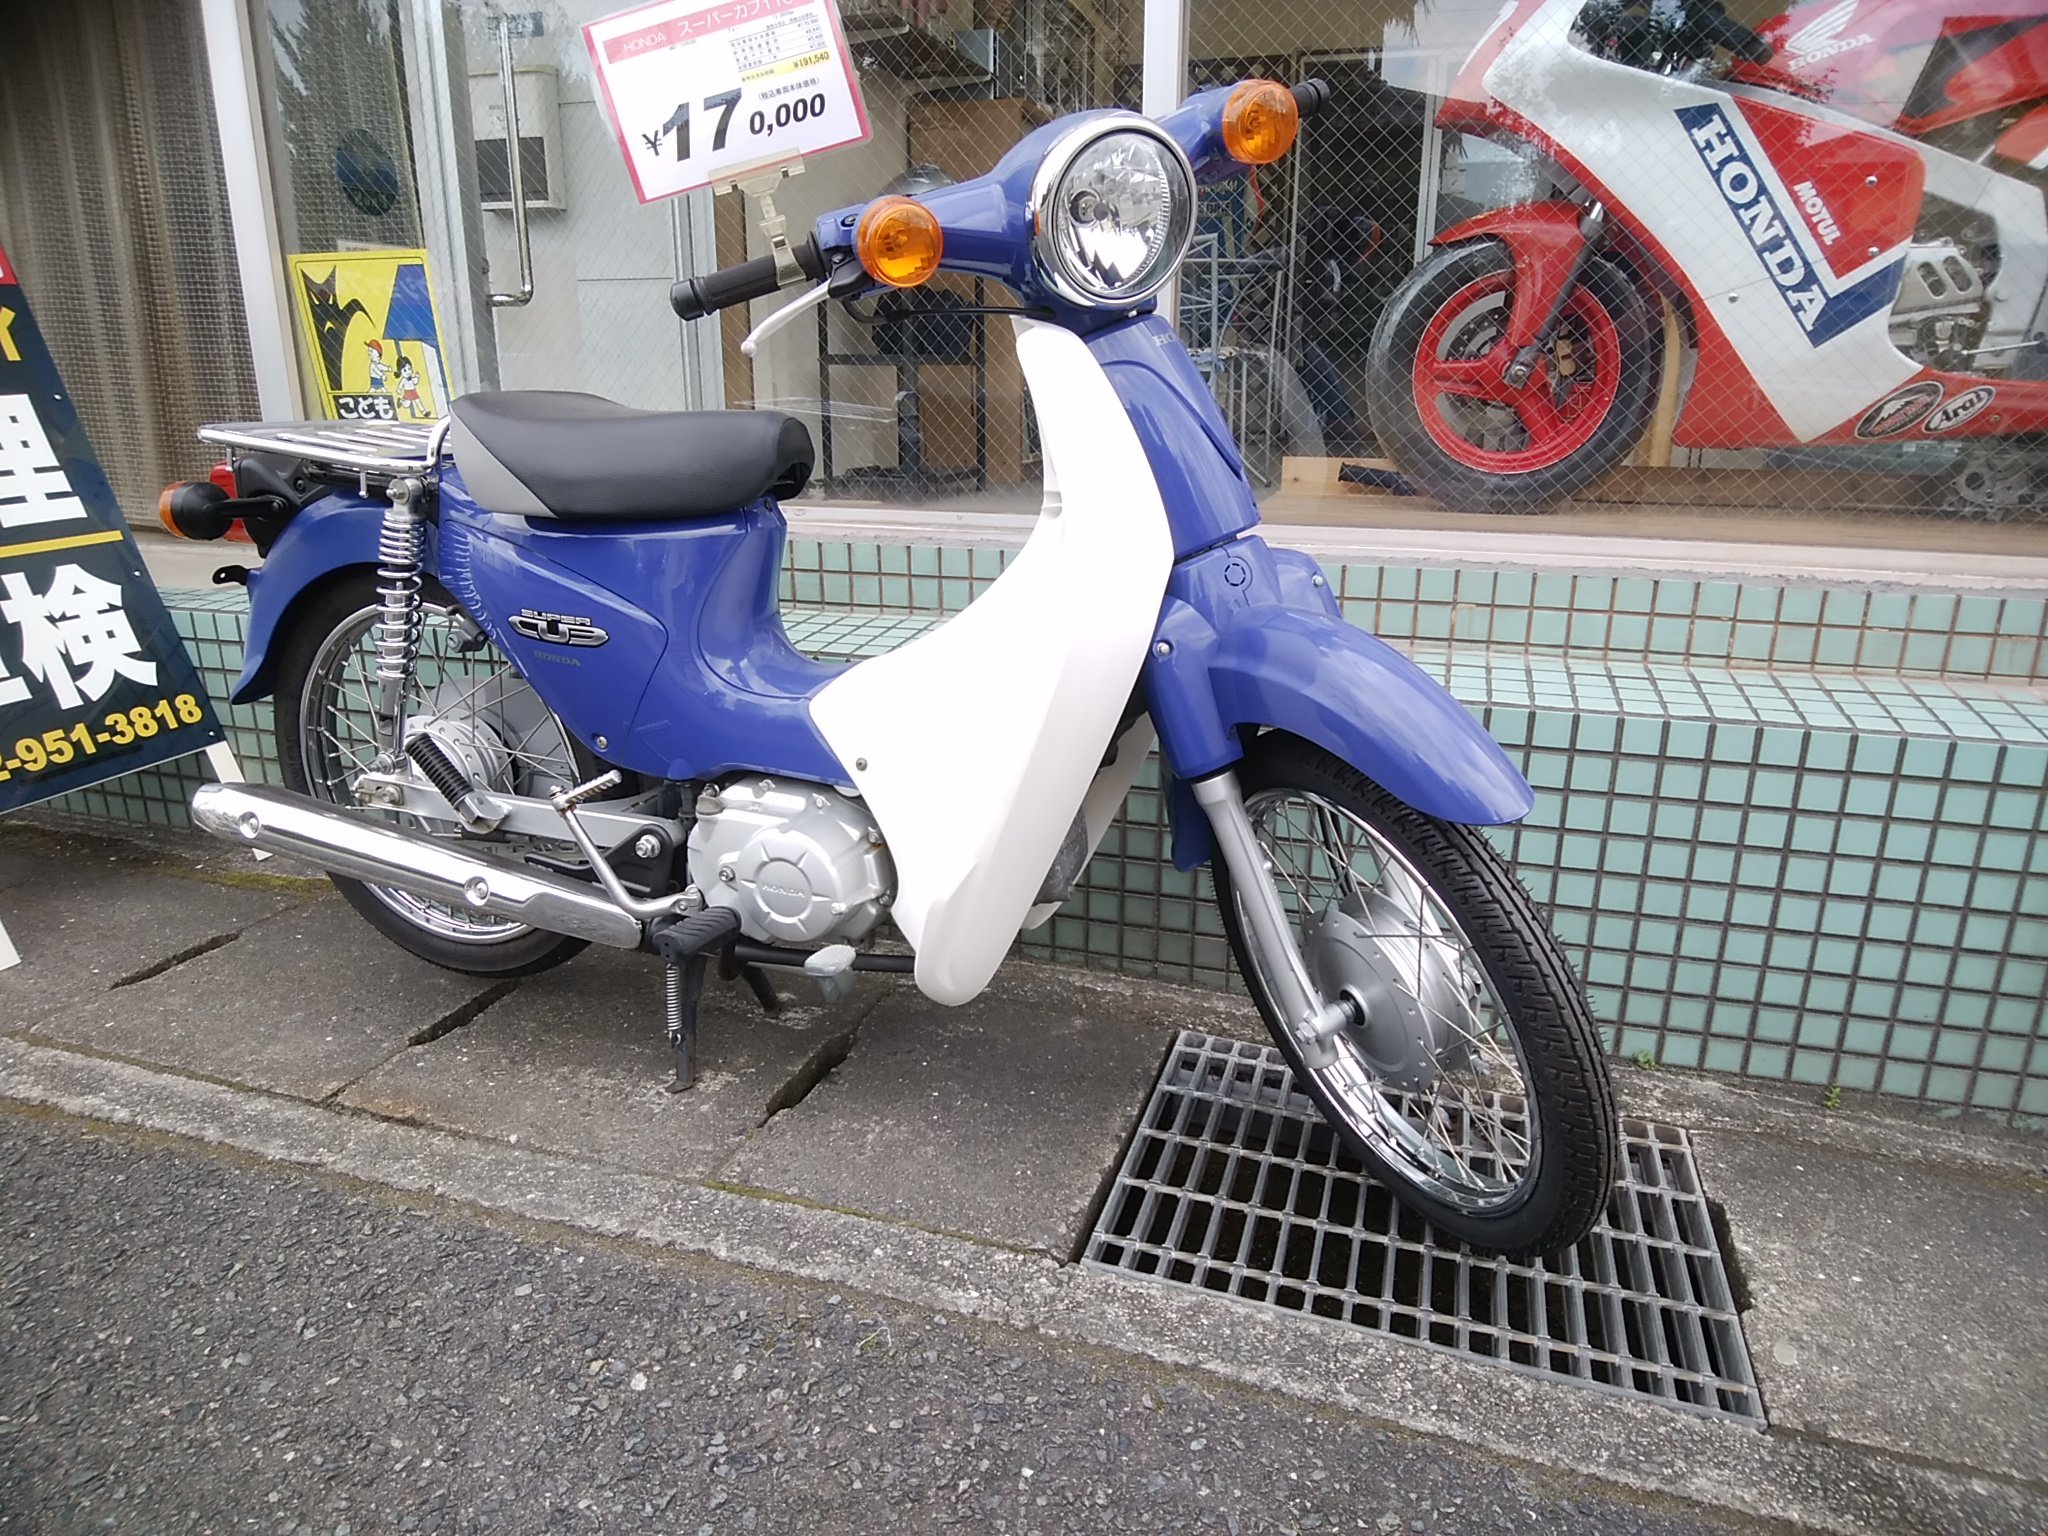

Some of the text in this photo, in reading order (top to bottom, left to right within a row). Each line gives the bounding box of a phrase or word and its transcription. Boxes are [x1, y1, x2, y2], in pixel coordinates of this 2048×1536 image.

[623, 31, 667, 53] HONDA
[792, 51, 830, 69] ¥191,540
[1787, 33, 1875, 71] HONDA
[1691, 114, 1827, 331] HONDA
[1793, 181, 1841, 246] MOTUL
[338, 396, 394, 420] こども
[1936, 390, 1985, 430] Arai
[520, 608, 592, 626] SUPER
[0, 563, 158, 711] 検
